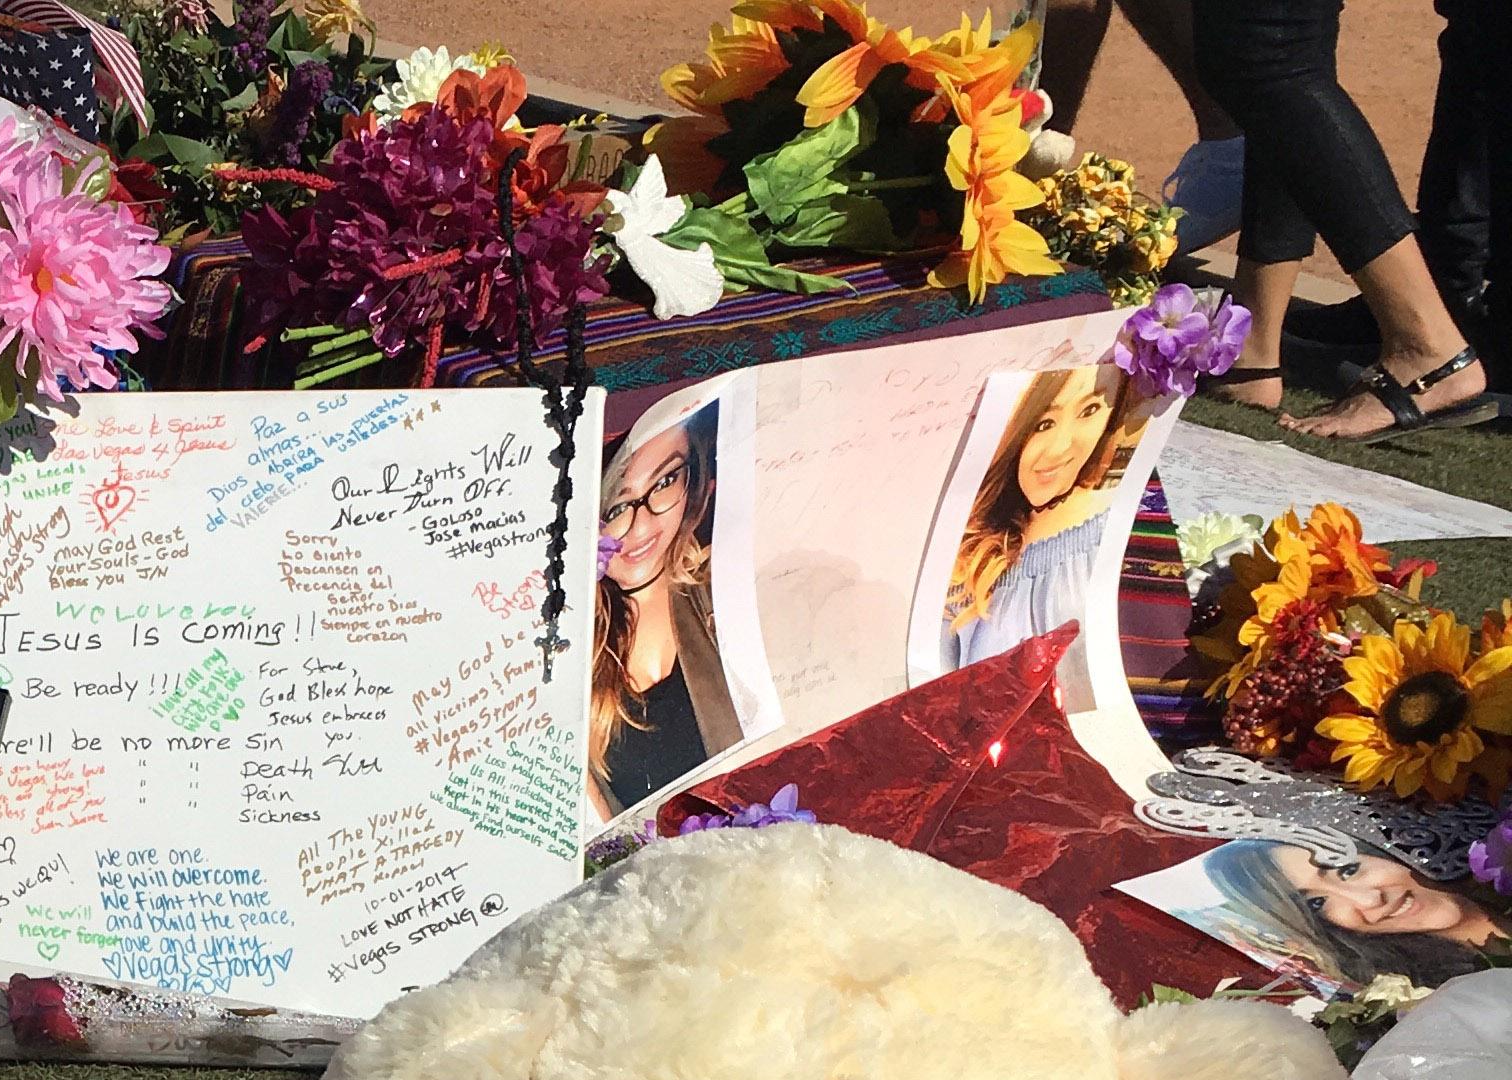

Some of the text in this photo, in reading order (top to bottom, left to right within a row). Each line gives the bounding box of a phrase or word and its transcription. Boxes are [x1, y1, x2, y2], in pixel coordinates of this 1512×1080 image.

[251, 416, 286, 443] Paz
[331, 476, 372, 501] Our
[471, 432, 532, 476] Will
[206, 474, 248, 504] Dios
[330, 509, 397, 531] Never
[98, 538, 136, 556] God
[285, 531, 338, 548] Sorry
[423, 527, 463, 546] Jose
[458, 641, 494, 681] God
[19, 671, 139, 702] Be ready
[259, 682, 296, 707] God
[71, 728, 102, 750] be
[120, 736, 152, 750] no
[165, 735, 231, 750] more
[240, 757, 313, 780] Death
[241, 783, 295, 802] Pain
[95, 849, 123, 868] We
[125, 849, 156, 866] are
[98, 871, 127, 889] We
[189, 890, 223, 907] the
[229, 890, 271, 907] hate
[106, 914, 143, 932] and
[200, 912, 236, 931] the
[341, 922, 378, 948] LOVE
[418, 884, 466, 918] HATE
[408, 908, 479, 946] STRONG
[159, 936, 197, 953] and
